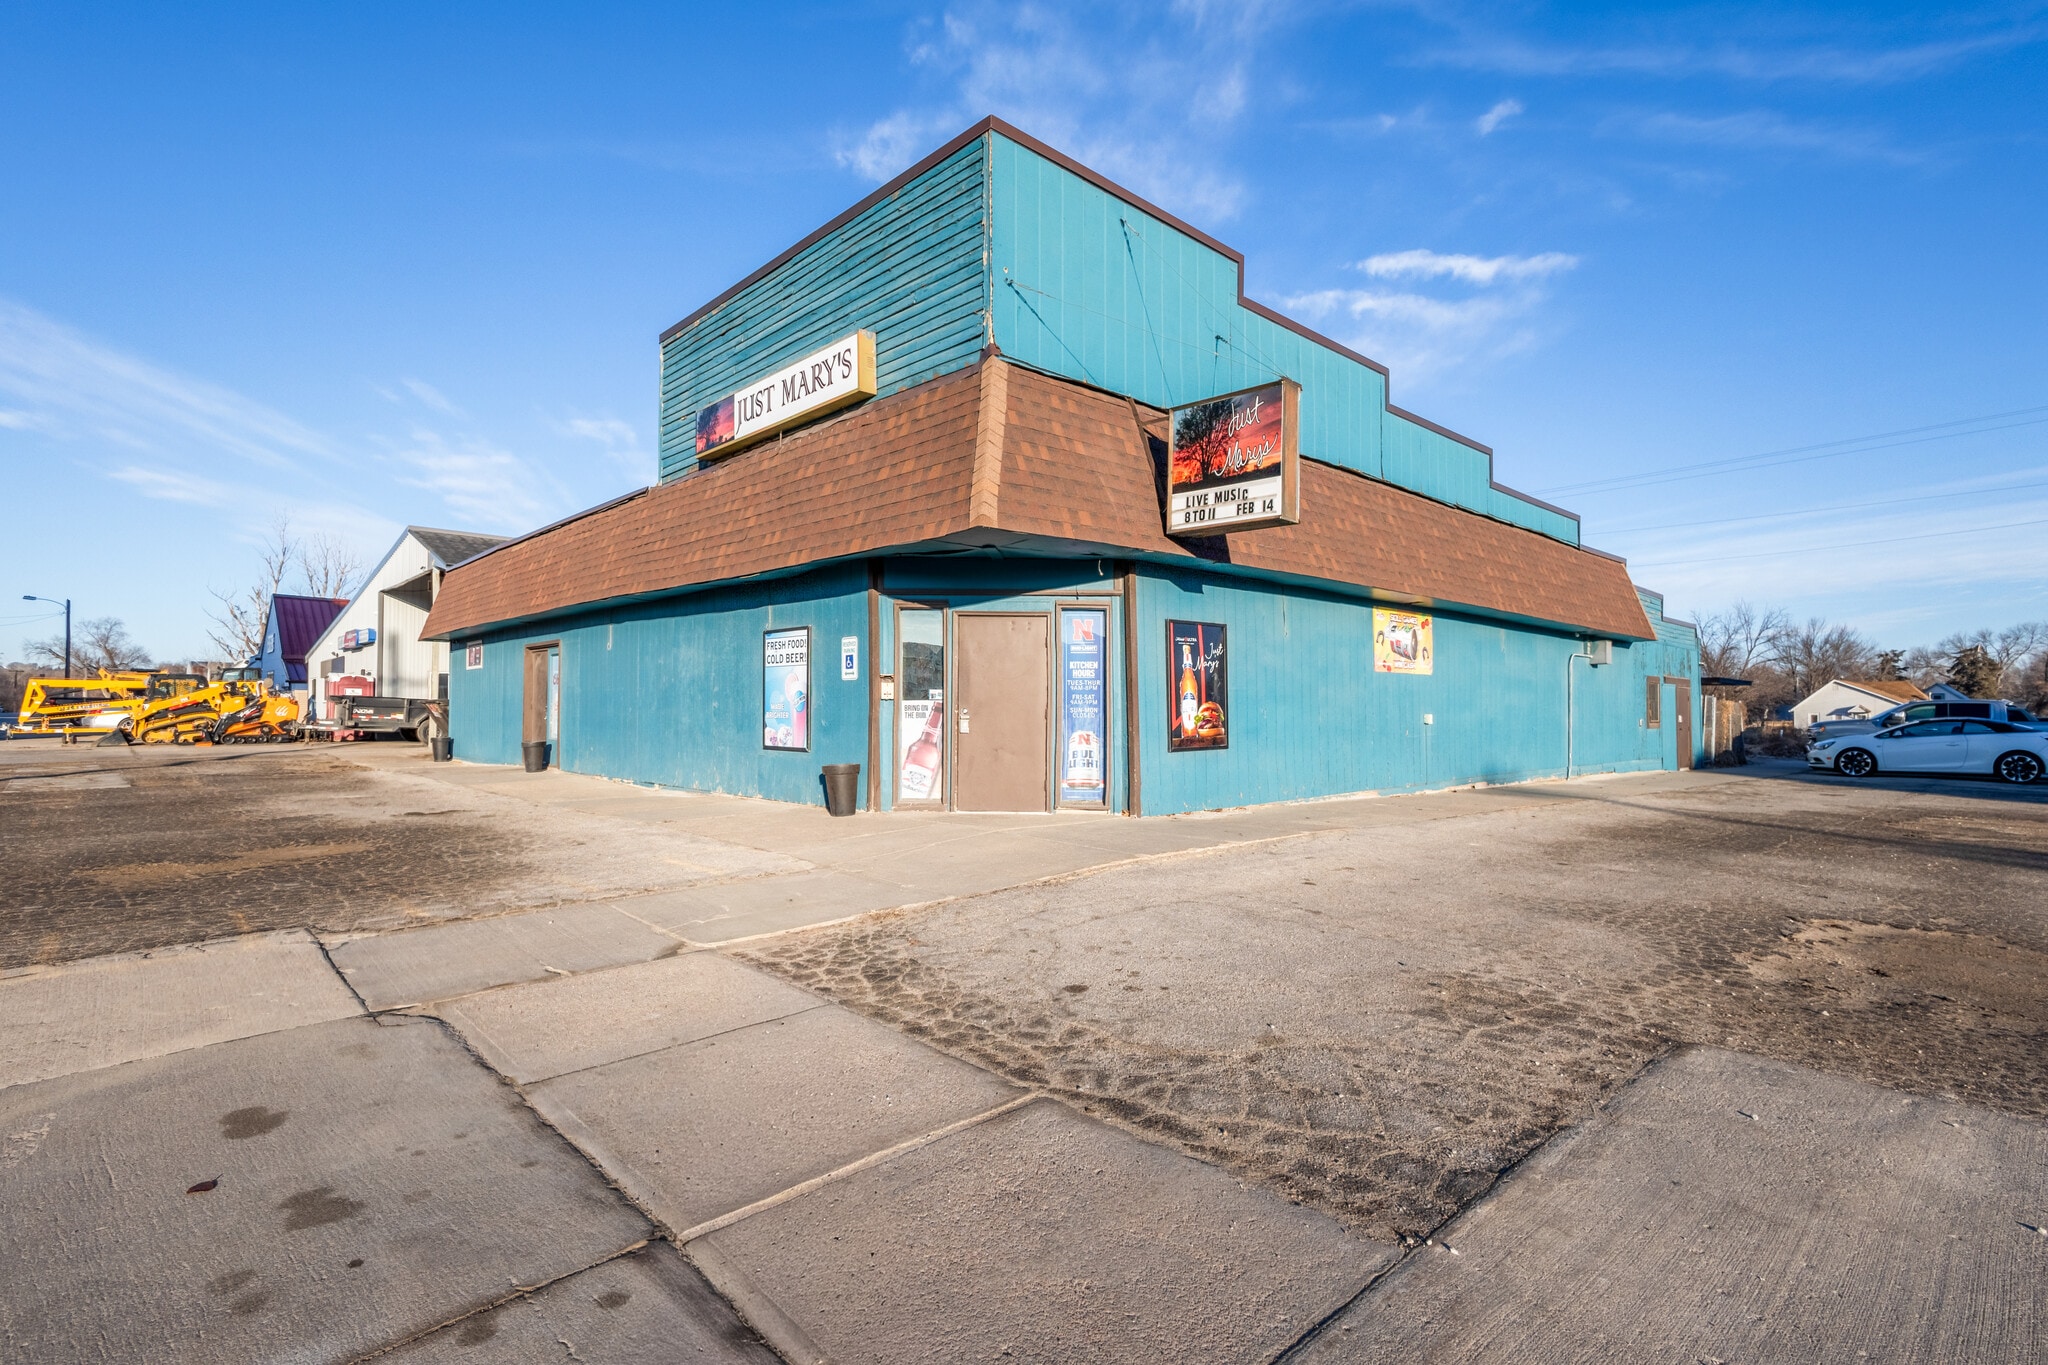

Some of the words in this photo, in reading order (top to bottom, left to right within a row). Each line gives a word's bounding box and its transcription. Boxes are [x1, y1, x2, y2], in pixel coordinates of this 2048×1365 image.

[736, 385, 775, 435] JUST
[781, 348, 853, 407] MARY'S
[1228, 396, 1265, 437] Just
[1213, 432, 1278, 476] Mary's
[1186, 494, 1209, 508] LIVE
[1214, 488, 1249, 504] MUSIC
[1236, 502, 1255, 516] FEB
[1262, 499, 1274, 512] 14
[766, 641, 787, 650] FRESH
[787, 639, 807, 648] FOOD!
[1205, 642, 1223, 660] Just
[766, 654, 784, 664] COLD
[786, 652, 807, 663] BEER!
[1069, 661, 1099, 669] KITCHEN
[1072, 669, 1096, 678] HOURS
[904, 711, 914, 719] THE
